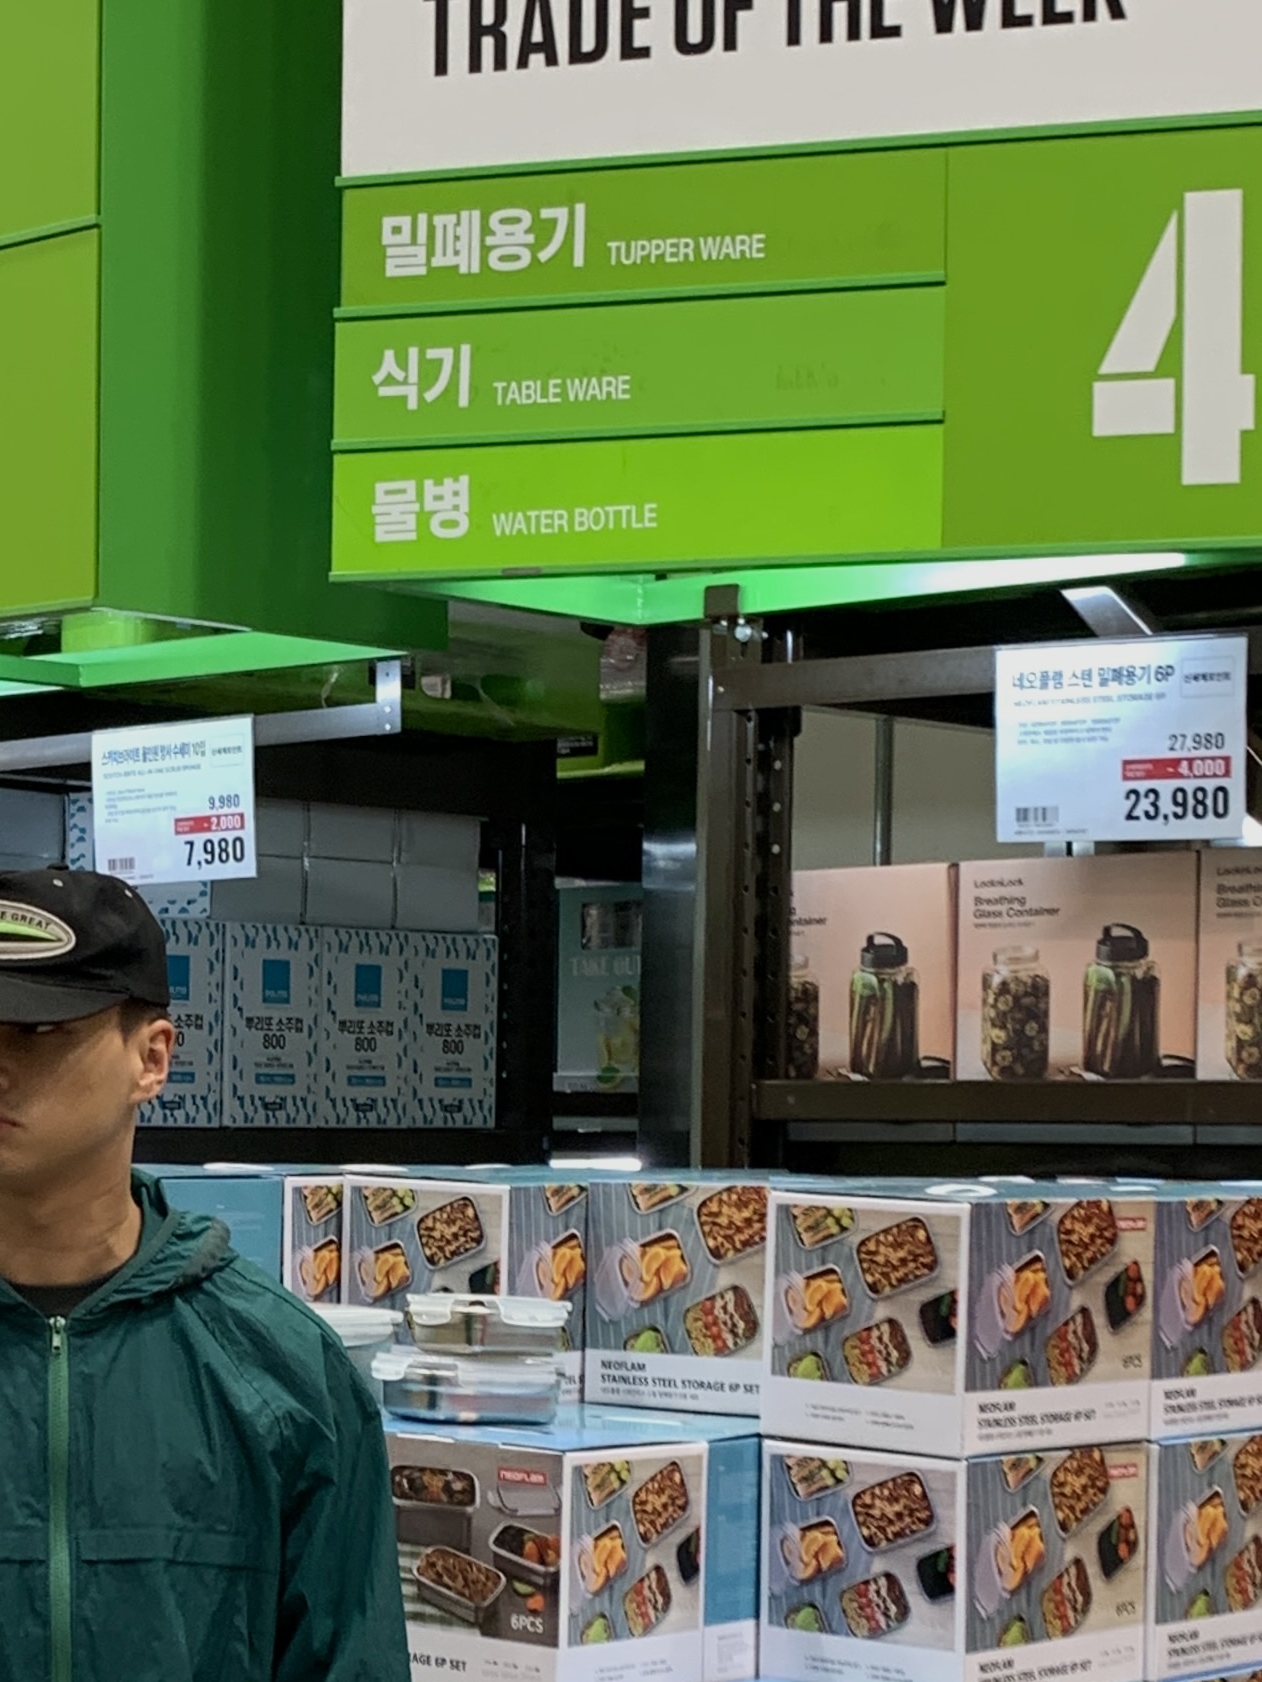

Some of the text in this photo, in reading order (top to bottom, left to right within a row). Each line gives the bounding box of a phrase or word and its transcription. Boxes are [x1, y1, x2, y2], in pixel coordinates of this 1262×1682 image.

[428, 0, 652, 77] TRADE
[381, 202, 586, 278] 밀폐용기
[607, 234, 766, 266] TUPPER WARE
[1092, 189, 1256, 485] 4
[371, 344, 471, 410] 식기
[492, 374, 631, 406] TABLE WARE
[370, 475, 470, 543] 물병
[492, 502, 657, 537] WATER BOTTLE
[1154, 664, 1176, 683] 6P
[1168, 732, 1225, 752] 27,980
[208, 794, 240, 811] 9,980
[1124, 785, 1230, 826] 23,980
[184, 836, 245, 870] 7,980
[973, 896, 1027, 908] Breathing
[11, 912, 52, 931] GREAT
[973, 906, 1061, 919] Glass Container
[263, 1033, 286, 1050] 800
[355, 1037, 377, 1053] 800
[600, 1359, 646, 1372] NEOFLAM
[600, 1373, 649, 1386] STAINLESS
[651, 1377, 677, 1389] STEEL
[681, 1379, 725, 1392] STORAGE
[511, 1613, 544, 1634] 6PCS
[449, 1658, 466, 1672] SET
